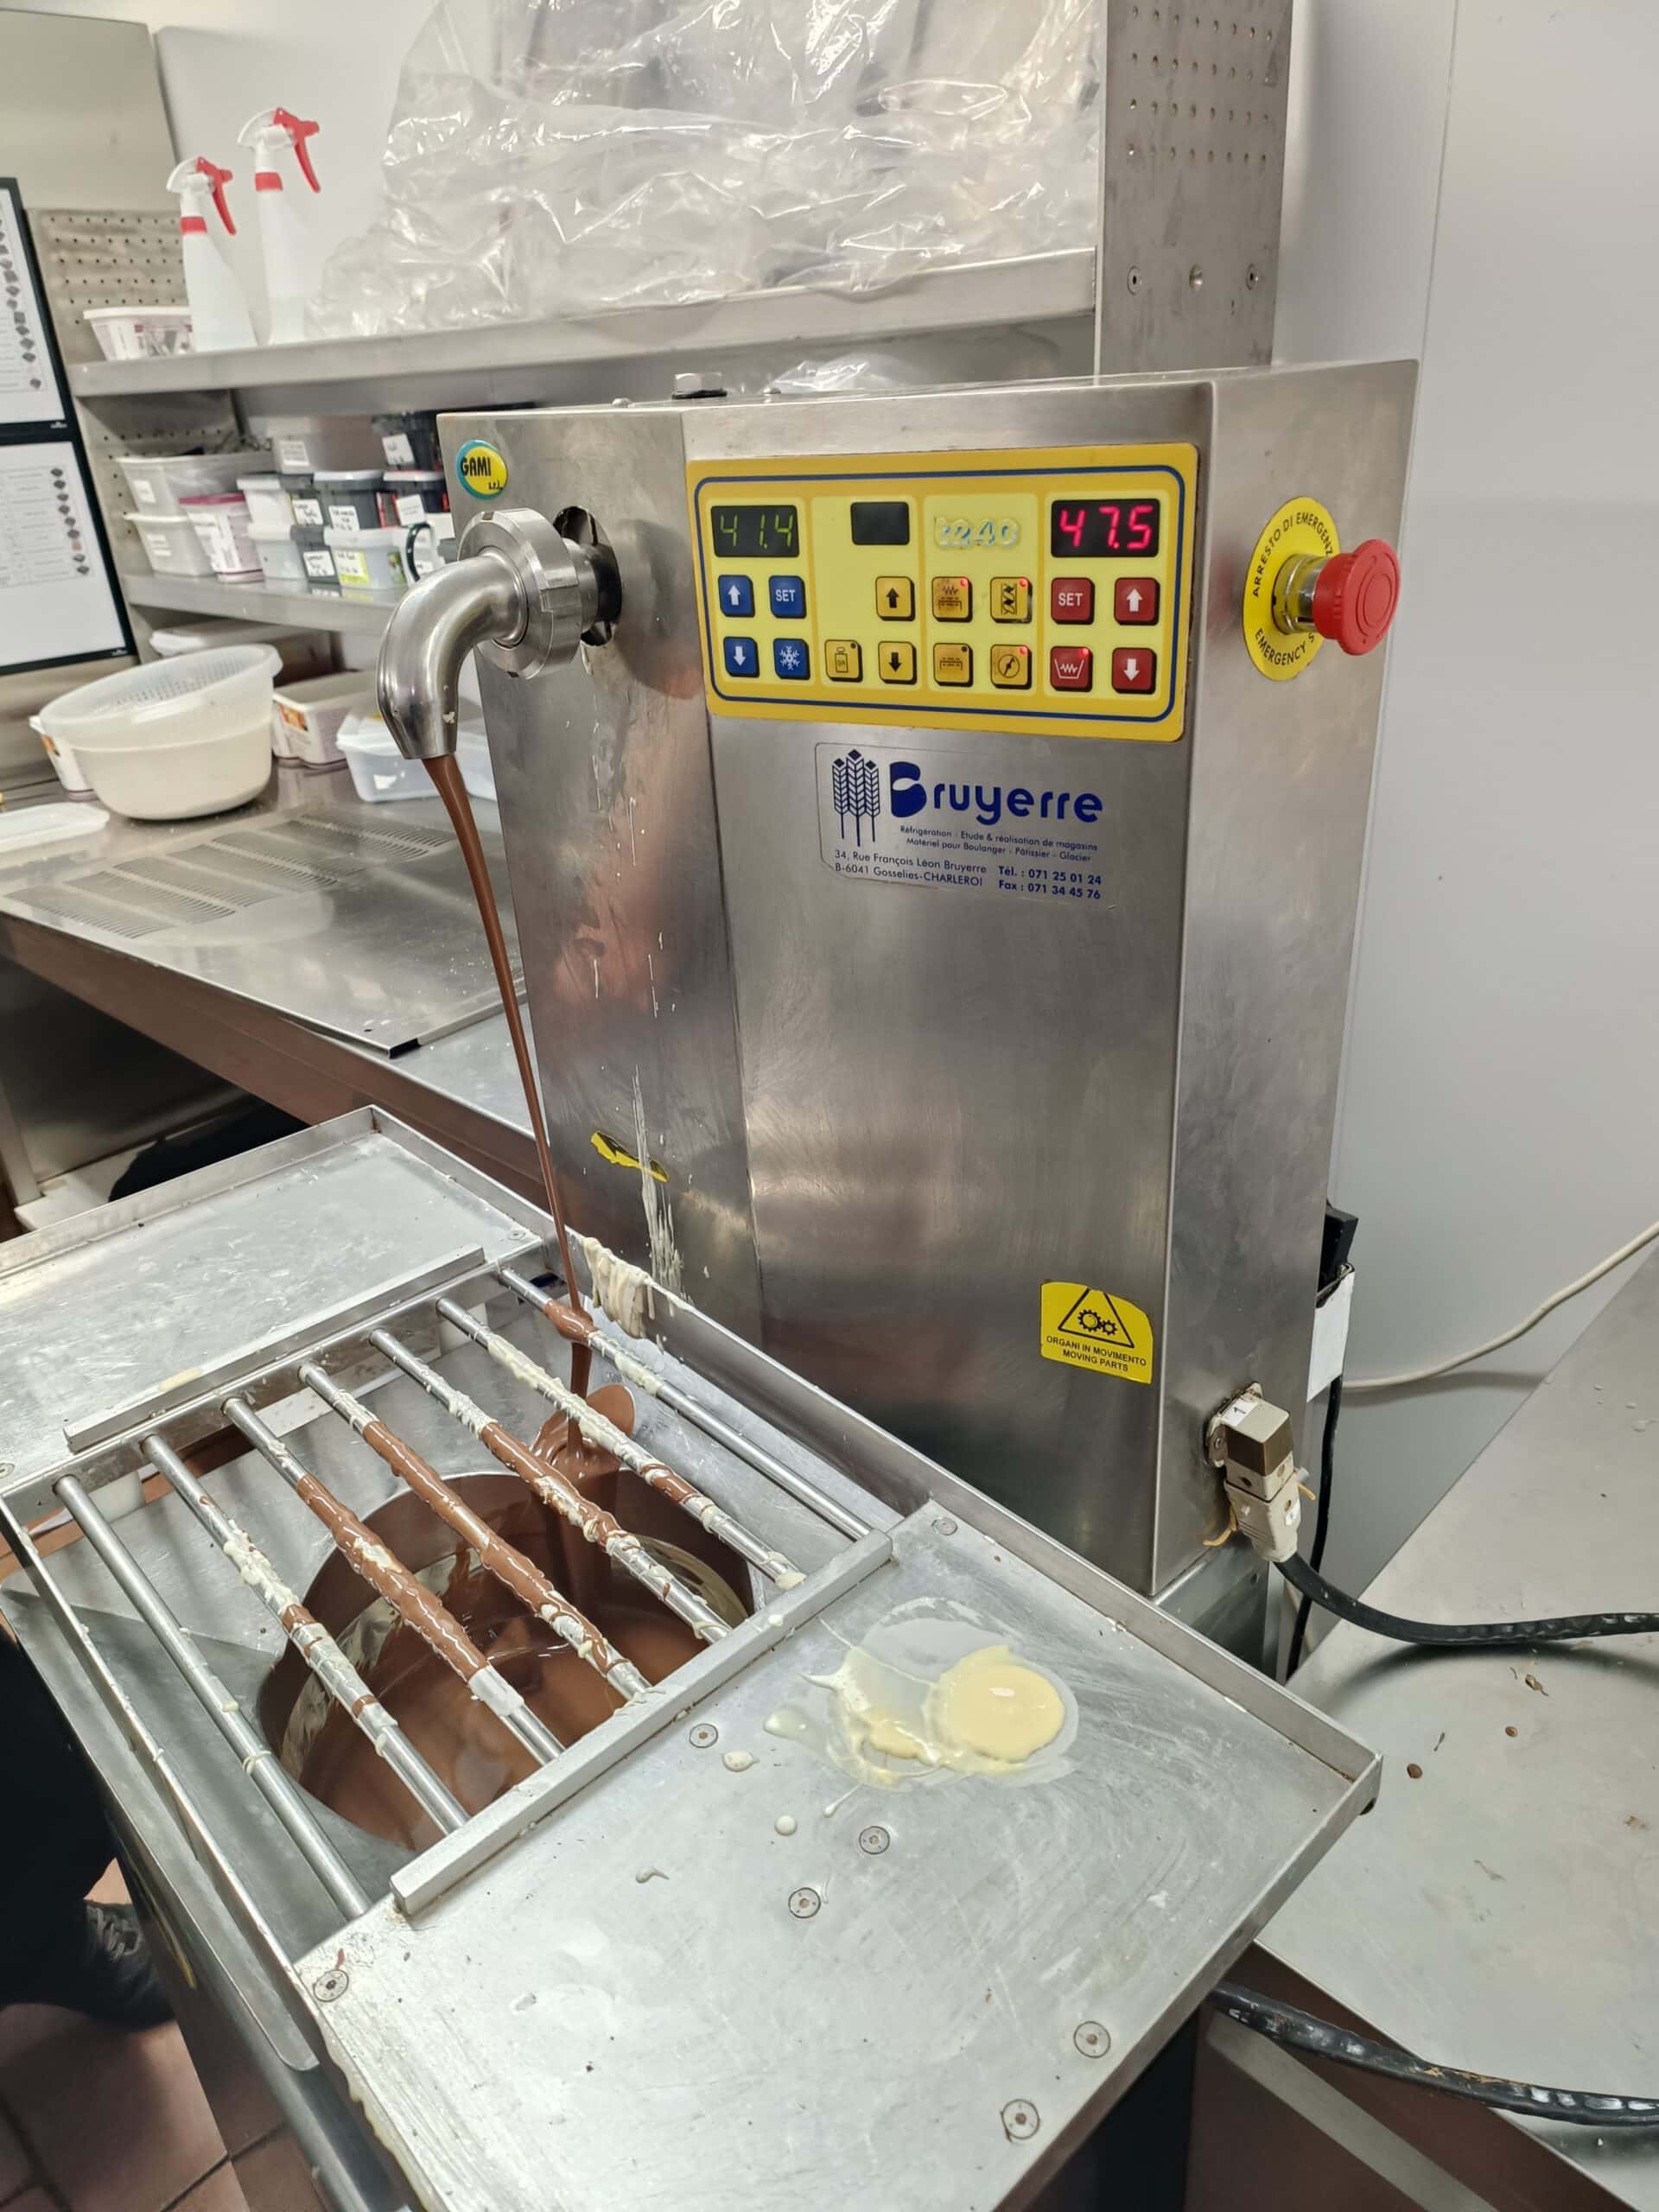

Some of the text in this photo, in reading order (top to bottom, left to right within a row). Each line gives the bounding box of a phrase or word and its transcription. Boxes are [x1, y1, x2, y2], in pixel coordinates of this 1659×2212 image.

[460, 456, 492, 477] GAMI
[1058, 505, 1154, 550] 47.5
[1252, 512, 1334, 598] ARRESTO DI EMERGENZ
[775, 588, 796, 602] SET
[1058, 592, 1084, 607] SET
[1254, 627, 1306, 666] EMERGENCY
[889, 760, 1103, 826] Bruyerre
[963, 842, 1006, 855] Boulanger
[1059, 851, 1091, 861] Glacier
[986, 833, 993, 842] &
[1056, 841, 1098, 851] magasins
[835, 849, 988, 874] 34, Rue François Léon Bruyerre
[835, 862, 982, 887] B-6041 Gosselies-CHARLEROI
[1028, 869, 1047, 880] 071
[1052, 871, 1067, 881] 25
[1070, 873, 1083, 883] 01
[1088, 874, 1102, 886] 24
[998, 880, 1018, 891] Fax
[1028, 882, 1047, 894] 071
[1052, 885, 1065, 895] 34
[1069, 887, 1084, 898] 45
[1087, 888, 1101, 899] 76
[1046, 1335, 1147, 1366] ORGANI IN MOVIMENTO
[1063, 1349, 1128, 1372] MOVING PARTS
